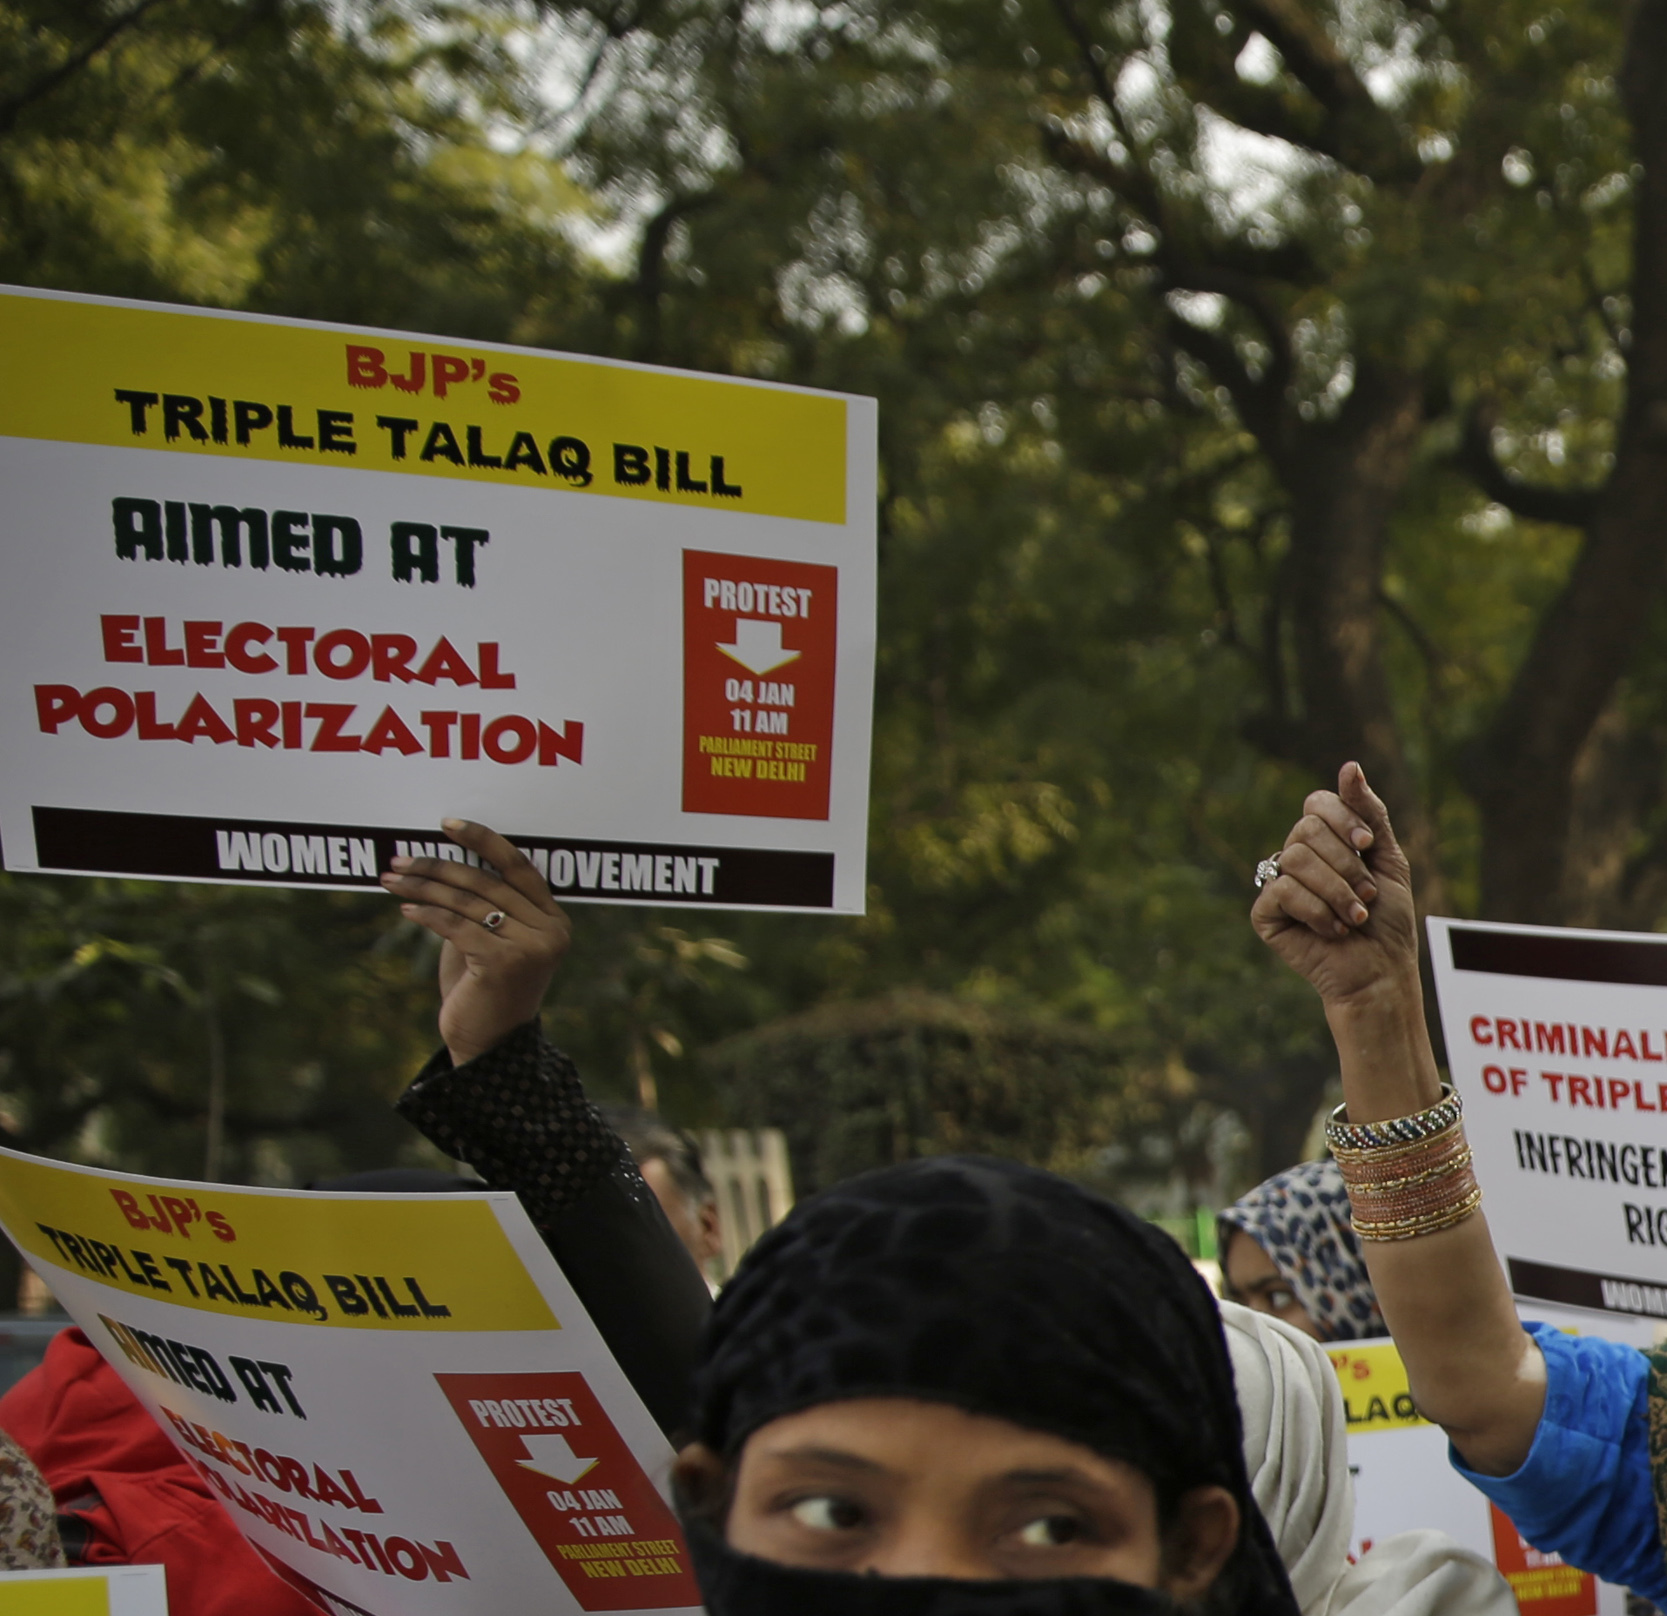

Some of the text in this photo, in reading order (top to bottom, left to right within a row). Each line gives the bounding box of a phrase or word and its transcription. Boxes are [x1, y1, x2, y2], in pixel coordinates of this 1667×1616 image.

[345, 345, 521, 405] BJP's
[115, 388, 743, 499] TRIPLE TALAQ BILL
[112, 496, 490, 589] AIMED AT
[704, 578, 812, 619] PROTEST
[100, 613, 516, 690] ELECTORAL
[725, 678, 794, 707] 04 JAN
[34, 684, 584, 767] POLARIZATION
[730, 708, 788, 735] 11 AM
[699, 735, 817, 761] PARLIAMENT STREET
[711, 756, 806, 782] NEW DELHI
[216, 830, 378, 877] WOMEN
[1481, 1064, 1528, 1097] OF
[109, 1189, 236, 1243] BJP's
[35, 1222, 451, 1321] TRIPLE TALAQ BILL
[228, 1355, 307, 1421] AT
[468, 1398, 582, 1427] PROTEST
[160, 1405, 385, 1514] ELECTORAL
[546, 1489, 623, 1511] 04 JAN
[569, 1515, 635, 1537] 11 AM
[556, 1539, 680, 1560] PARLIAMENT STREET
[579, 1557, 683, 1578] NEW DELHI
